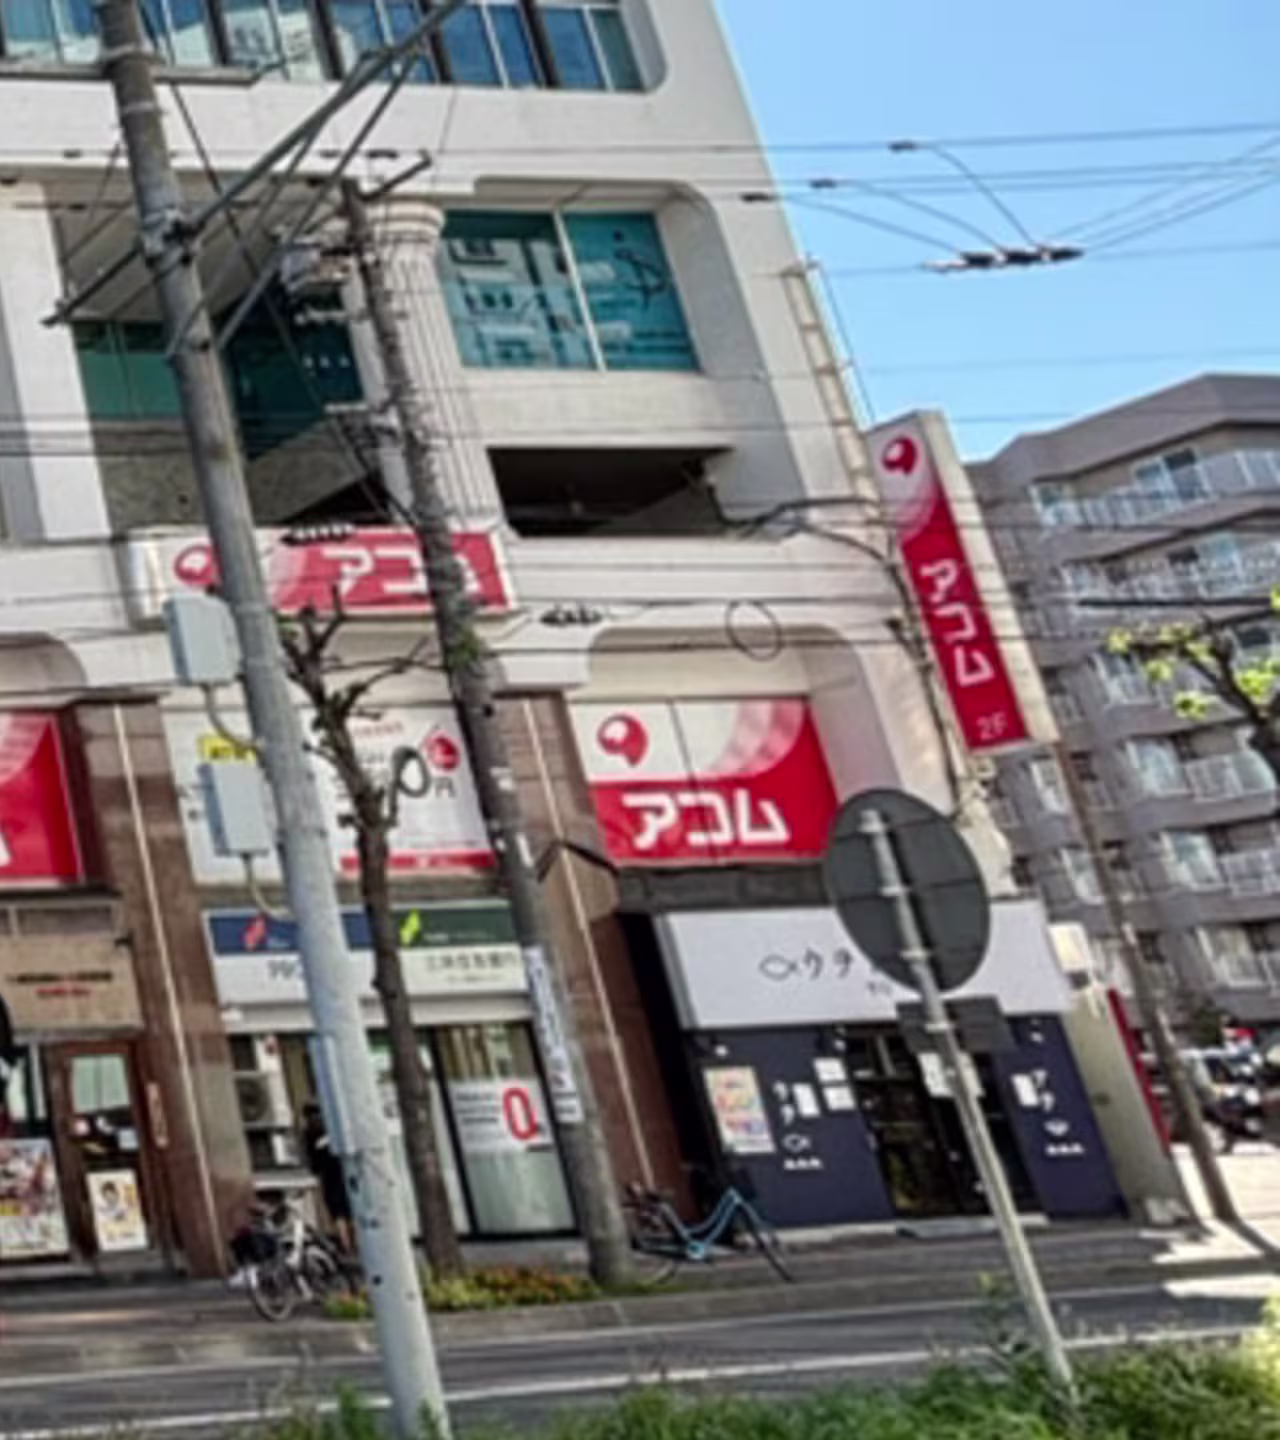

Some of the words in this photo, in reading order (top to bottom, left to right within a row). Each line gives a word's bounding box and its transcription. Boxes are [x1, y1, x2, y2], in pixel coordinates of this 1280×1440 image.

[920, 558, 995, 688] アコム
[622, 789, 790, 849] アコム
